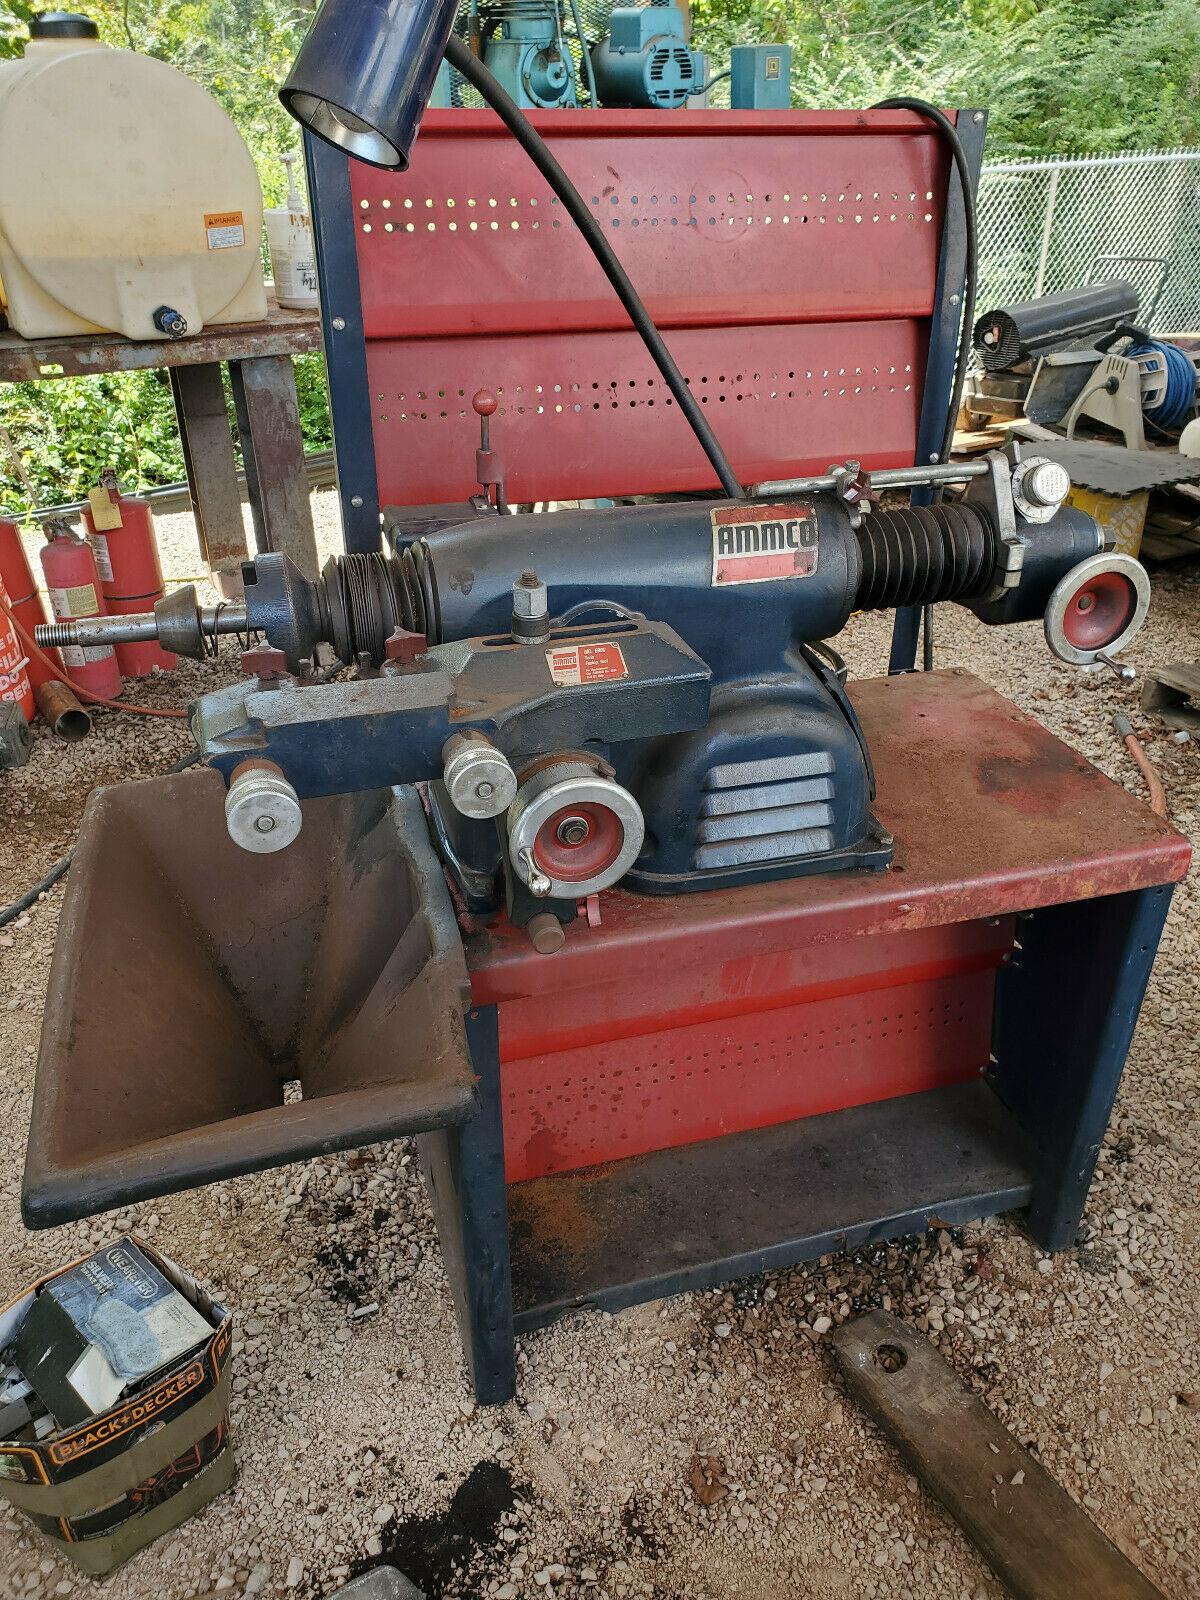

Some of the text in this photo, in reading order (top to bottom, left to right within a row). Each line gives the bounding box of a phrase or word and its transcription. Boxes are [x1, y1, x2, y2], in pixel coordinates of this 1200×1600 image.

[718, 521, 817, 555] AMMCO
[86, 1260, 114, 1290] SILVER
[110, 1251, 154, 1296] WEAREVER
[60, 1371, 197, 1456] BLACK+DECKER
